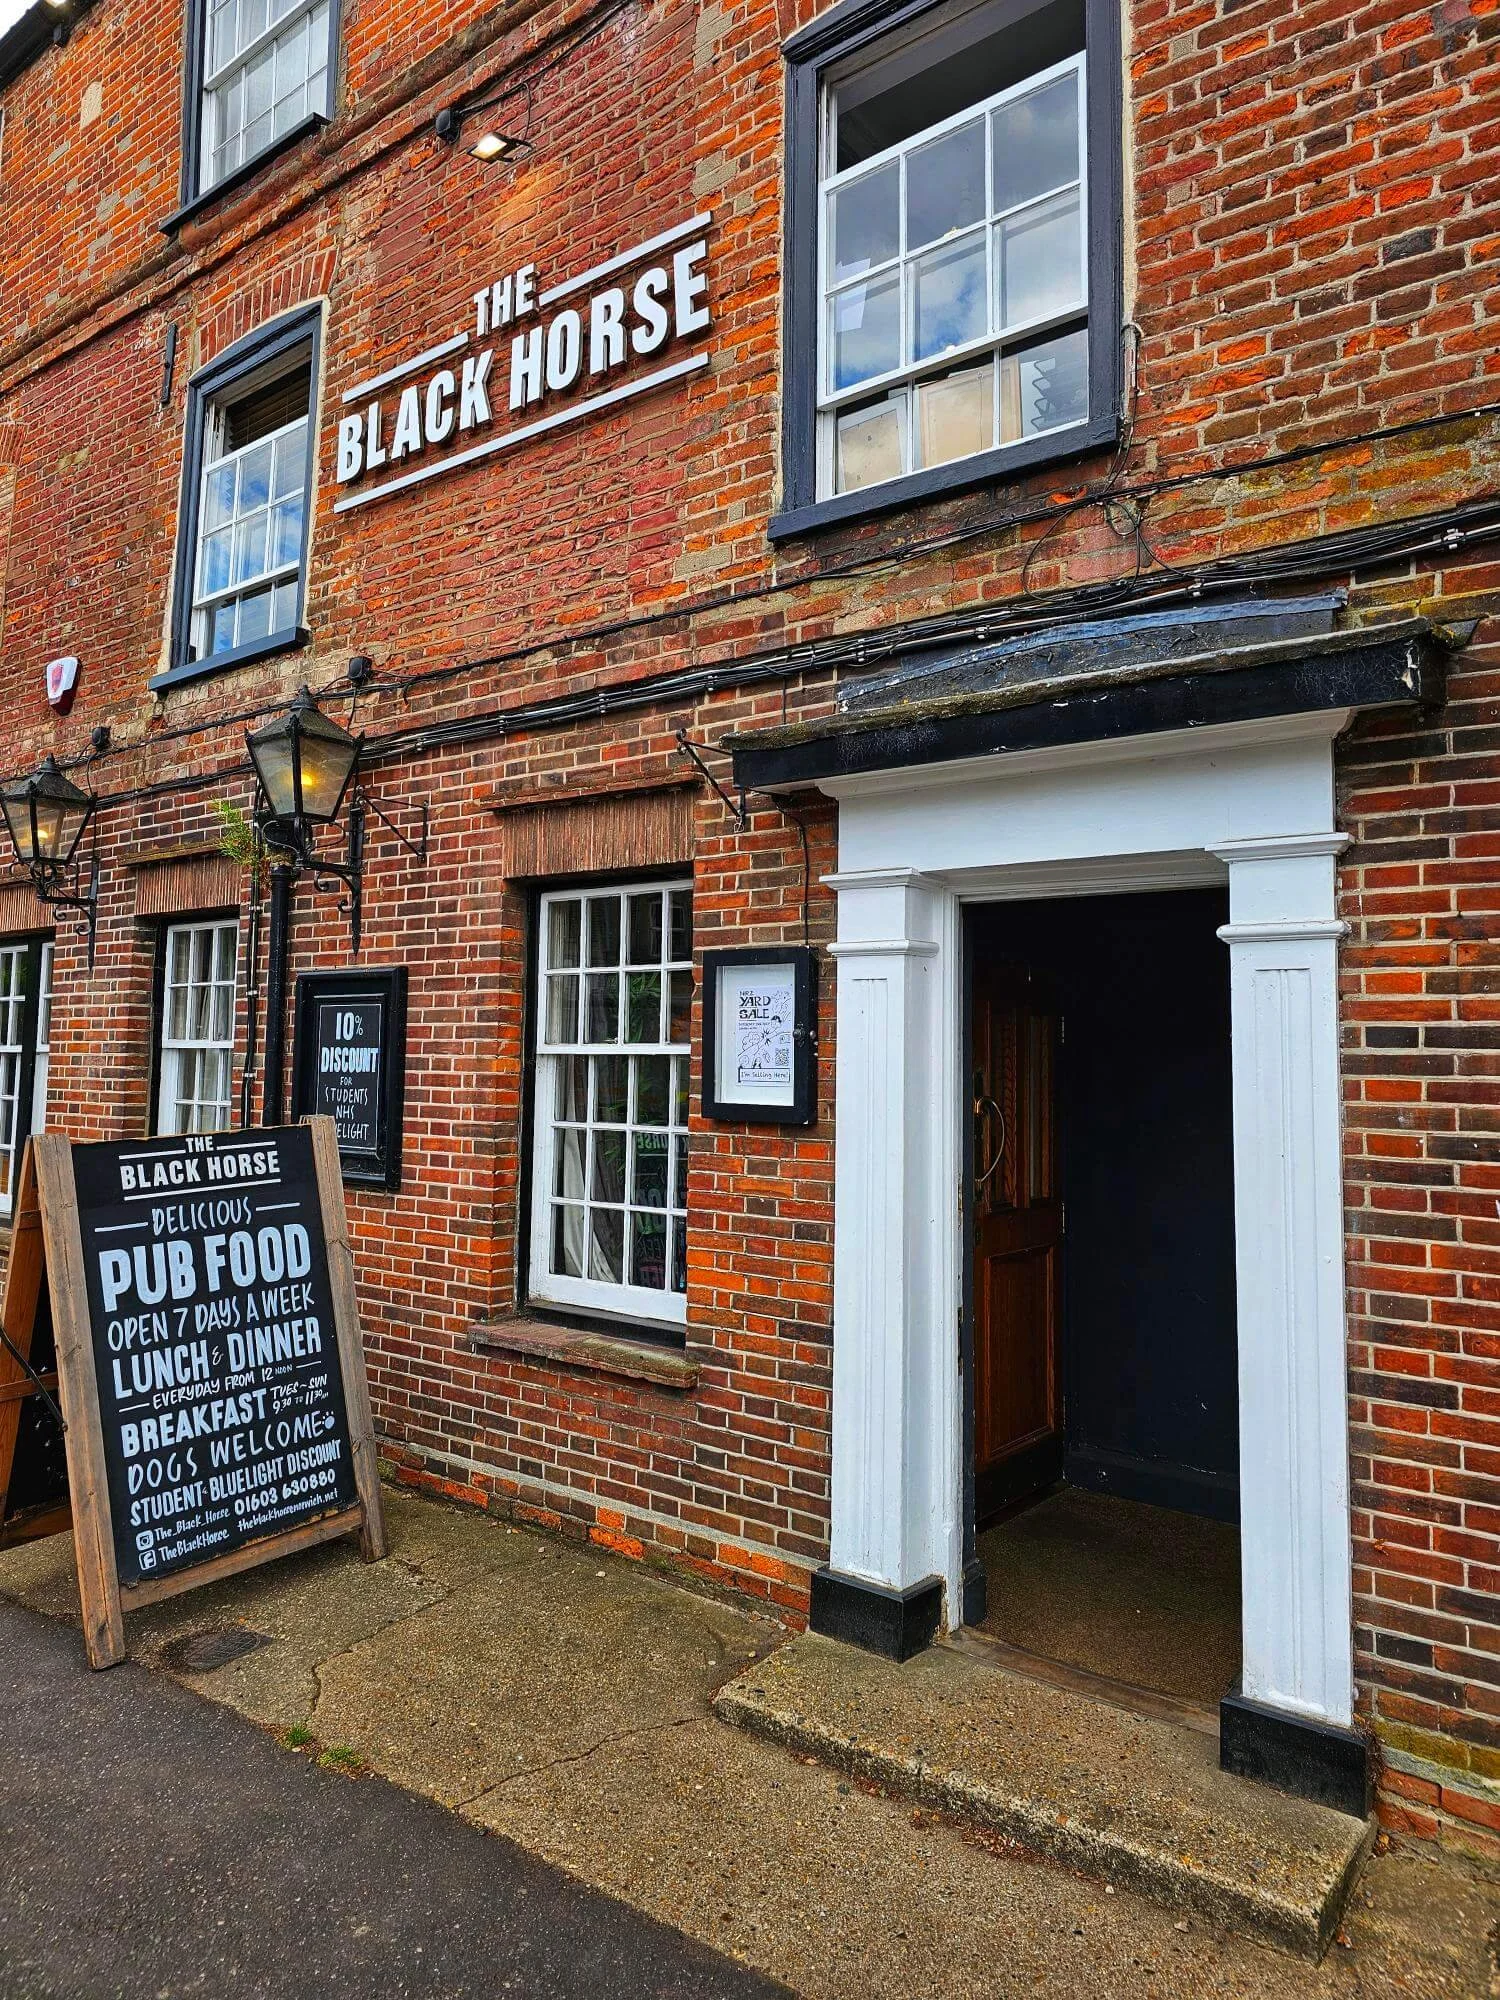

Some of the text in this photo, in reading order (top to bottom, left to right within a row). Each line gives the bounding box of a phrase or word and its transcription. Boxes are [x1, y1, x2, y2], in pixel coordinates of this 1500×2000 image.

[473, 263, 539, 335] THE
[336, 240, 712, 483] BLACK HORSE
[739, 996, 771, 1007] YARD
[739, 1008, 770, 1019] SALE
[335, 1012, 363, 1041] 10%
[321, 1047, 379, 1073] DISCOUNT
[325, 1086, 368, 1106] STUDENTS
[340, 1076, 353, 1086] FOR
[335, 1104, 354, 1120] NHS
[336, 1122, 369, 1141] ELIGHT
[185, 1135, 214, 1153] THE
[119, 1150, 281, 1191] BLACK HORSE
[151, 1196, 252, 1236] DELICIOUS
[98, 1223, 312, 1313] PUB FOOD
[107, 1282, 315, 1352] OPEN 7 DAYS A WEEK
[112, 1316, 322, 1400] LUNCH & DINNER
[153, 1364, 293, 1411] EVERYDAY FROM 12 NOON
[120, 1387, 267, 1459] BREAKFAST
[127, 1410, 323, 1496] DOGS WELCOME
[129, 1480, 204, 1527] STUDENT
[208, 1456, 284, 1503] BLUELIGHT
[286, 1439, 341, 1476] DISCOUNT
[234, 1468, 336, 1516] 01603 630880
[158, 1528, 230, 1562] TheBlackHorse
